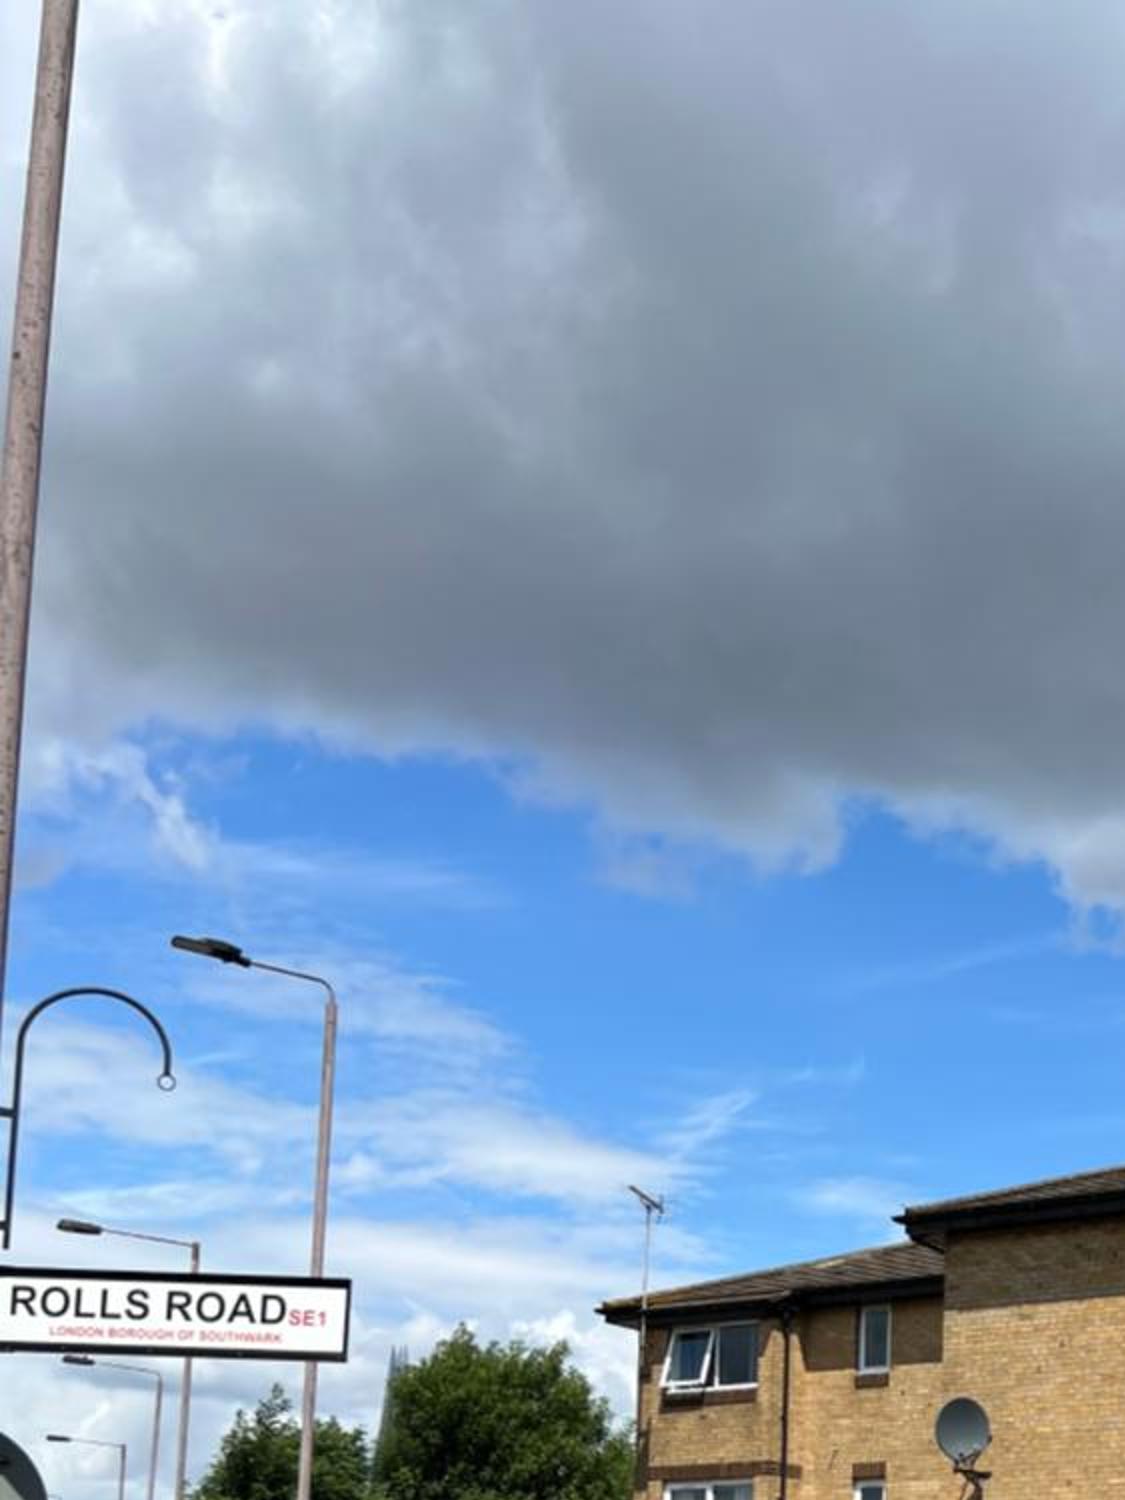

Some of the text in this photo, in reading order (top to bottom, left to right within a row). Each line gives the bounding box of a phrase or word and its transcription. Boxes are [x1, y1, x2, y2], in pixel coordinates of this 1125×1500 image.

[9, 1284, 328, 1327] ROLLS ROAD SE1
[48, 1326, 282, 1344] LONDON BOROUGH OF SOUTHWARK
